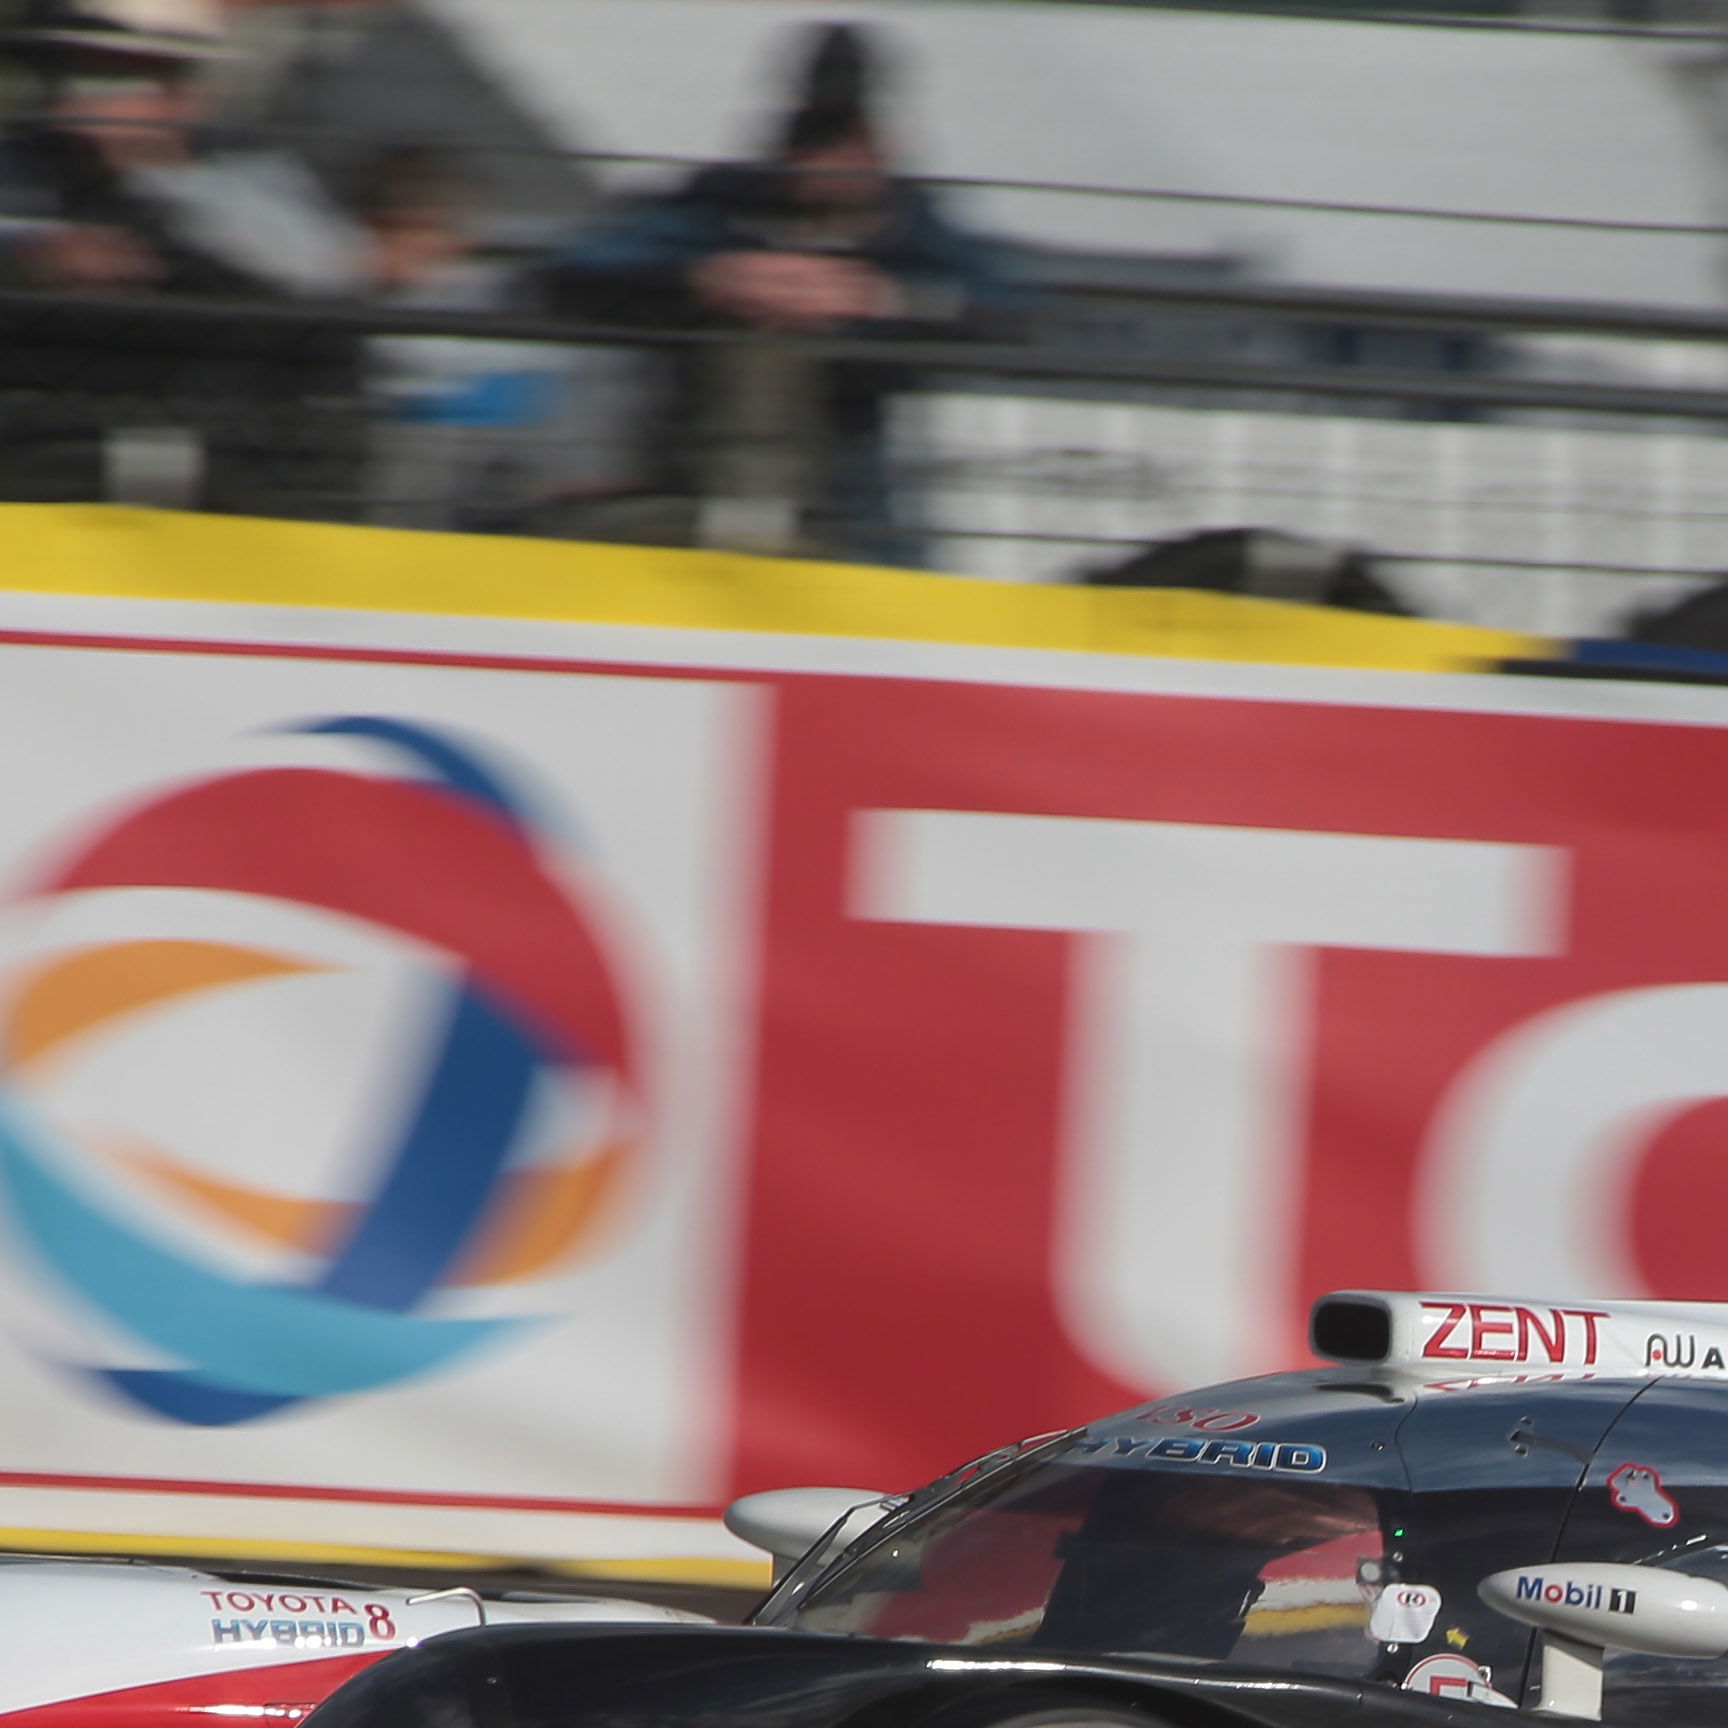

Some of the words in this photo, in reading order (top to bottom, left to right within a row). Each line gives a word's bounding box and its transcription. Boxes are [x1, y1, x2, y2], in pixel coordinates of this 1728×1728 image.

[1419, 1301, 1611, 1366] ZENT
[1070, 1436, 1328, 1474] HYBRID
[1516, 1576, 1603, 1609] Mobil
[200, 1591, 358, 1615] TOYOTA
[364, 1603, 396, 1640] 8
[211, 1618, 366, 1647] HYBRID
